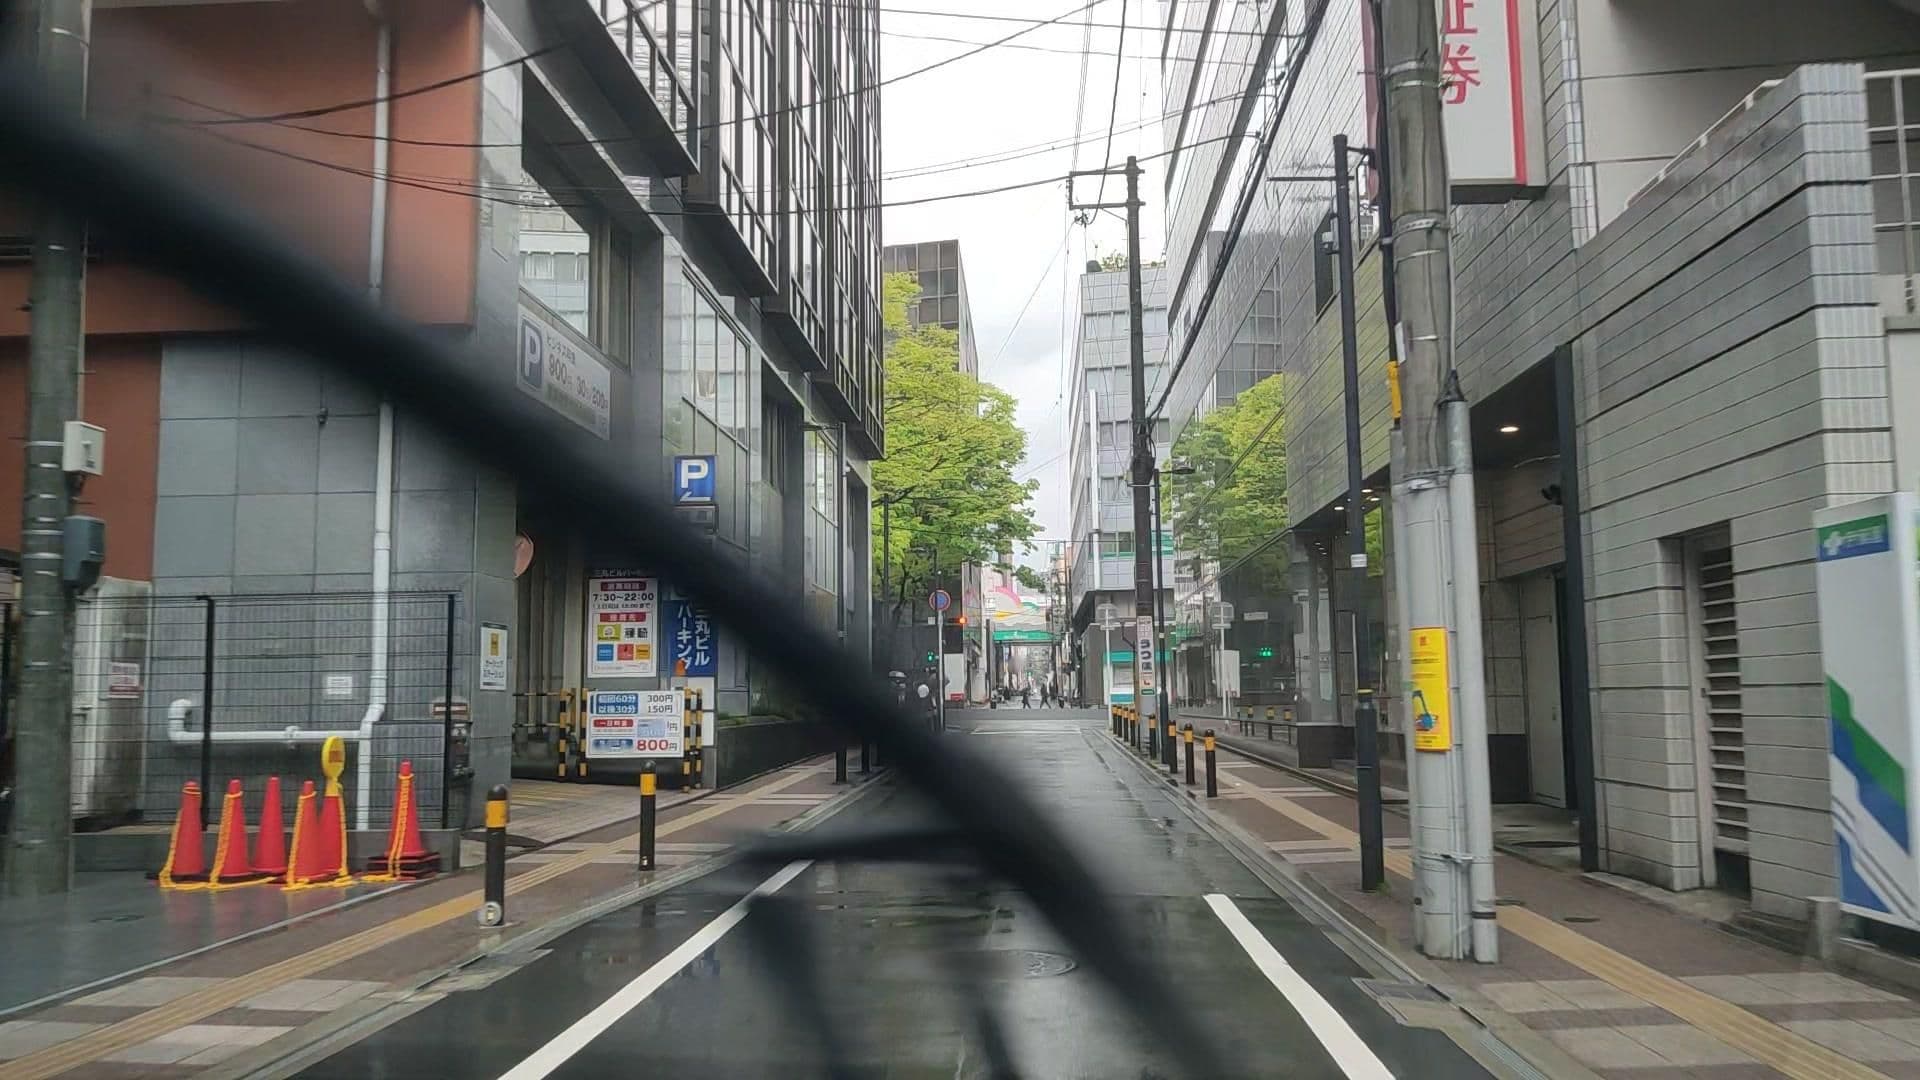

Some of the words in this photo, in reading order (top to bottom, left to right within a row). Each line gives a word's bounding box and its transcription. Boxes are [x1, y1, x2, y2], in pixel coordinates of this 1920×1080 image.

[524, 325, 541, 376] P
[681, 459, 709, 489] P
[647, 694, 674, 703] 300円
[647, 705, 673, 714] 150円
[637, 739, 678, 752] 800円
